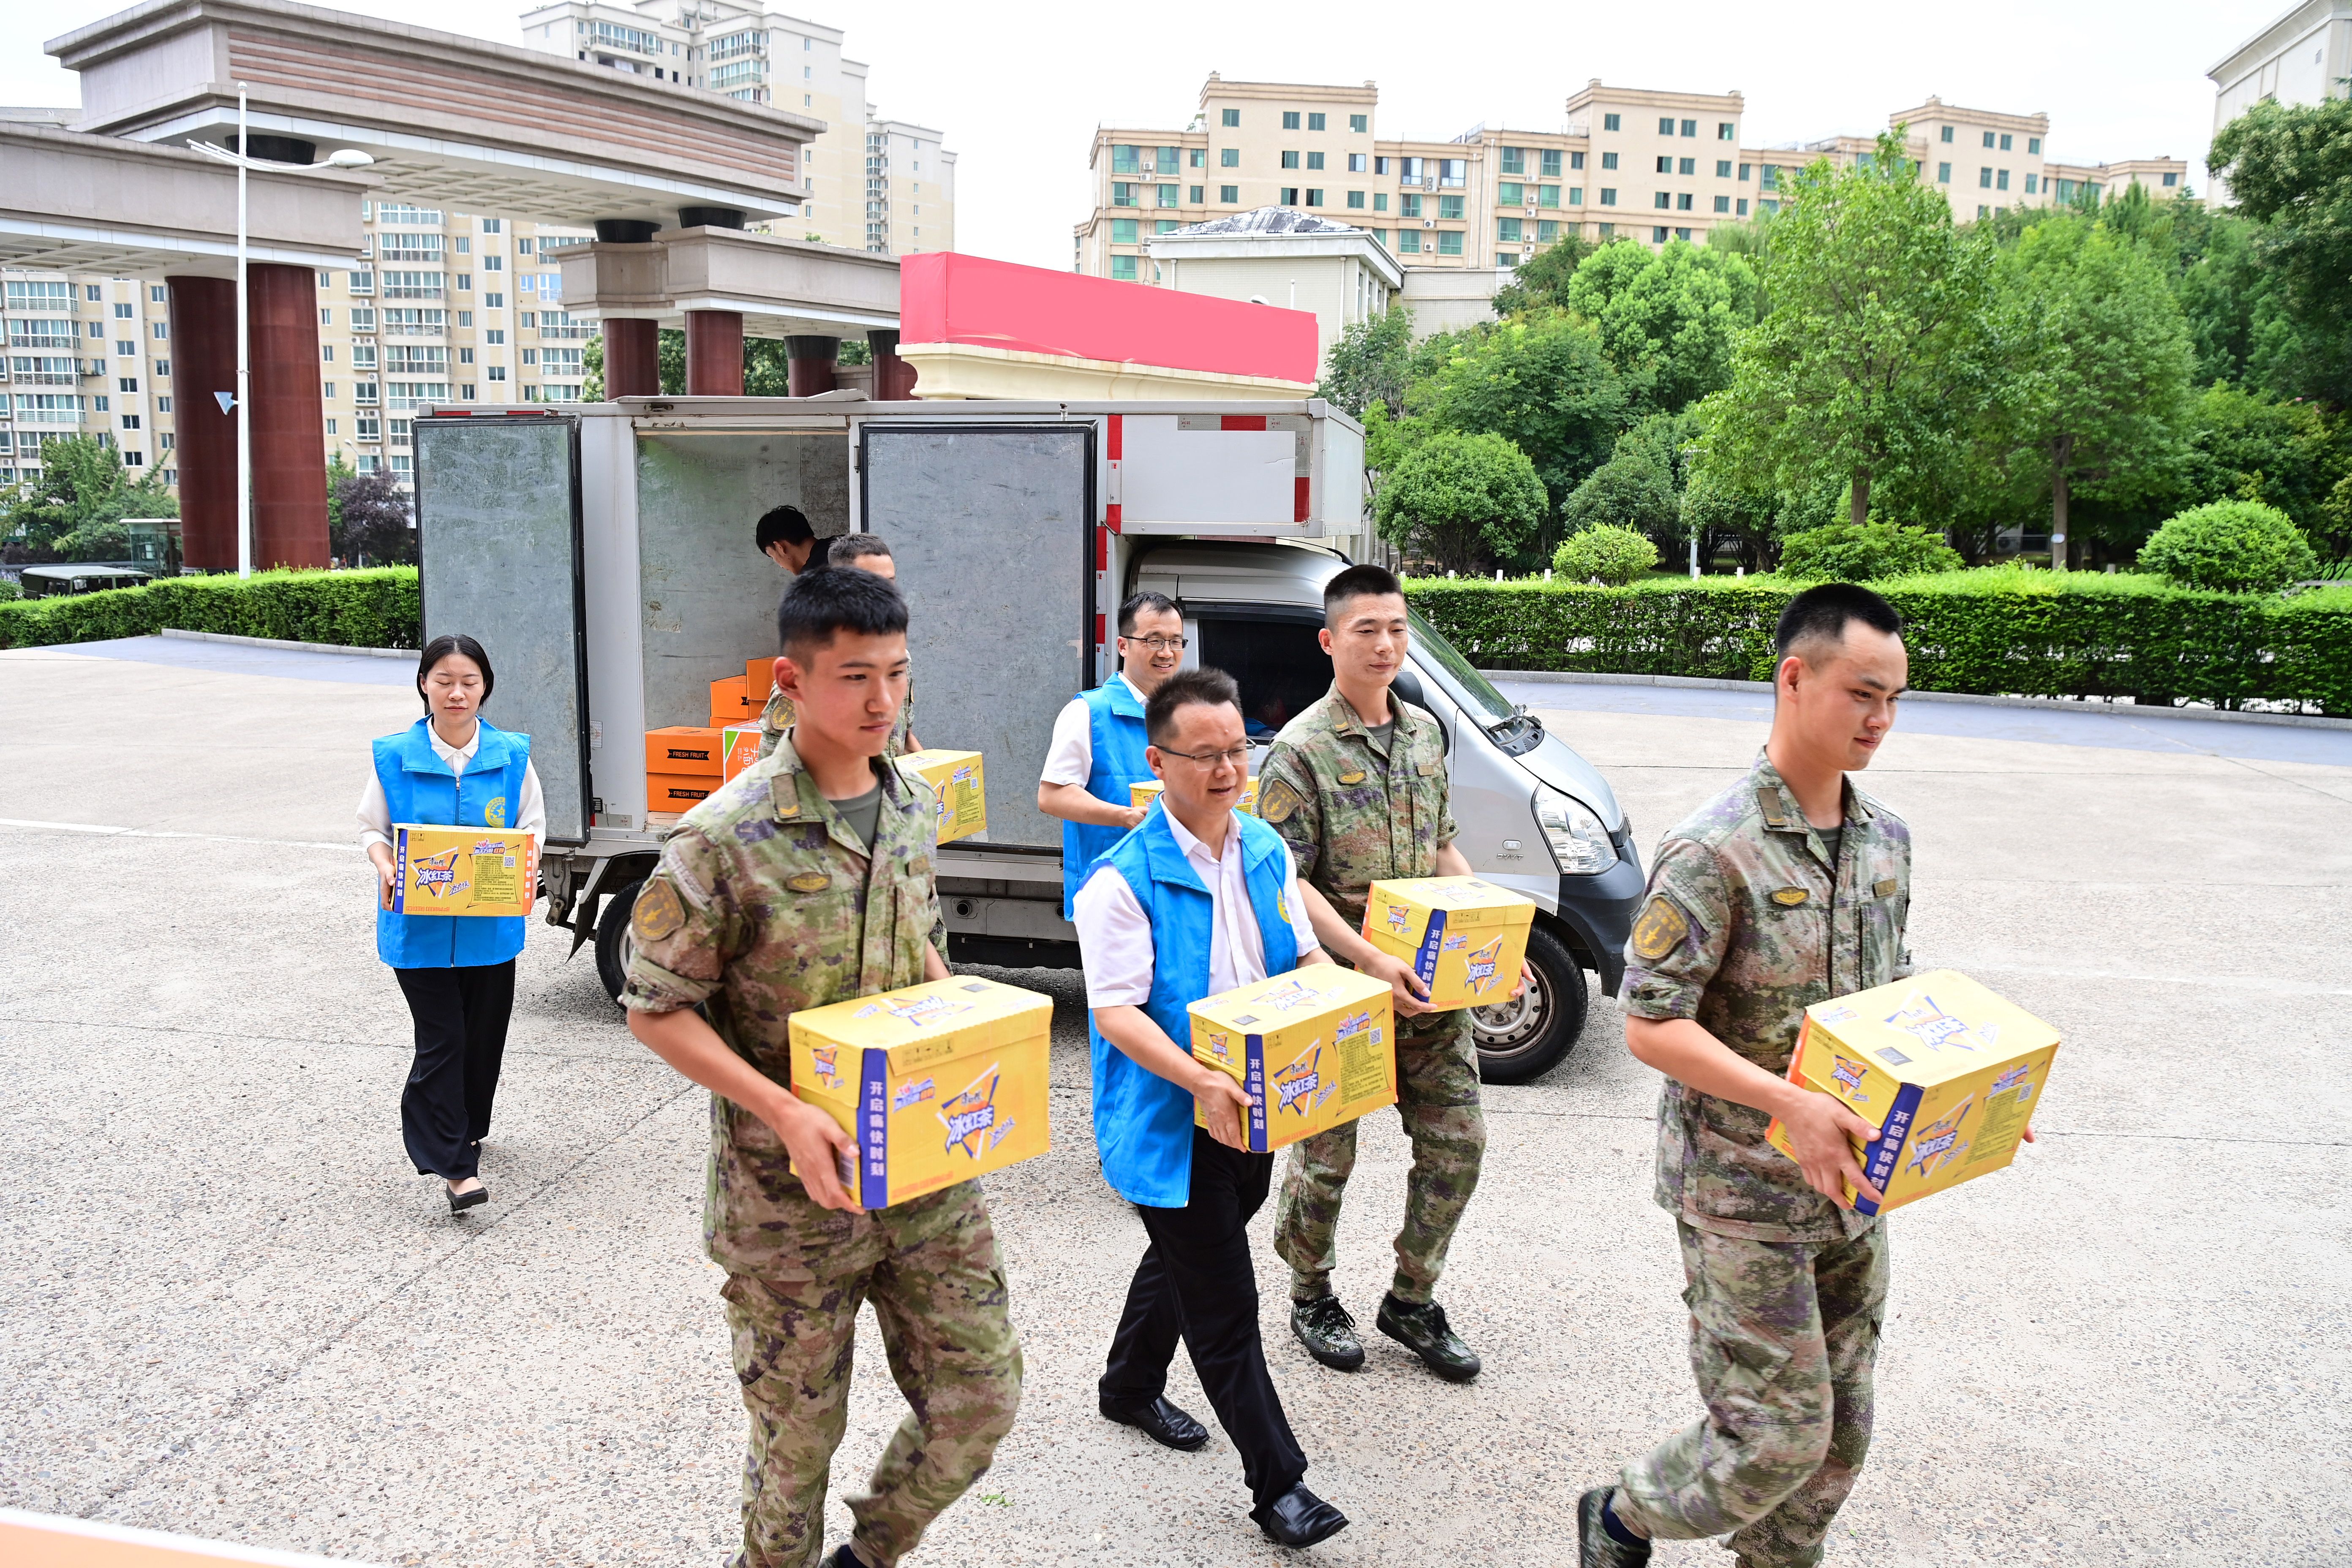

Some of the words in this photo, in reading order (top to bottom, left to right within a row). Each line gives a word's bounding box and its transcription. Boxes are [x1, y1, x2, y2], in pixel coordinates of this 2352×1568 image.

[397, 846, 405, 896] 开启痛快时刻
[416, 868, 454, 890] 冰红茶
[1465, 961, 1496, 989] 冰红茶
[1250, 1059, 1264, 1129] 开启痛快时刻
[1278, 1072, 1318, 1114] 冰红茶
[869, 1081, 884, 1176] 开启痛快时刻
[945, 1105, 994, 1155] 冰红茶
[1870, 1110, 1910, 1190] 开启痛快时刻
[1905, 1130, 1957, 1175] 冰红茶
